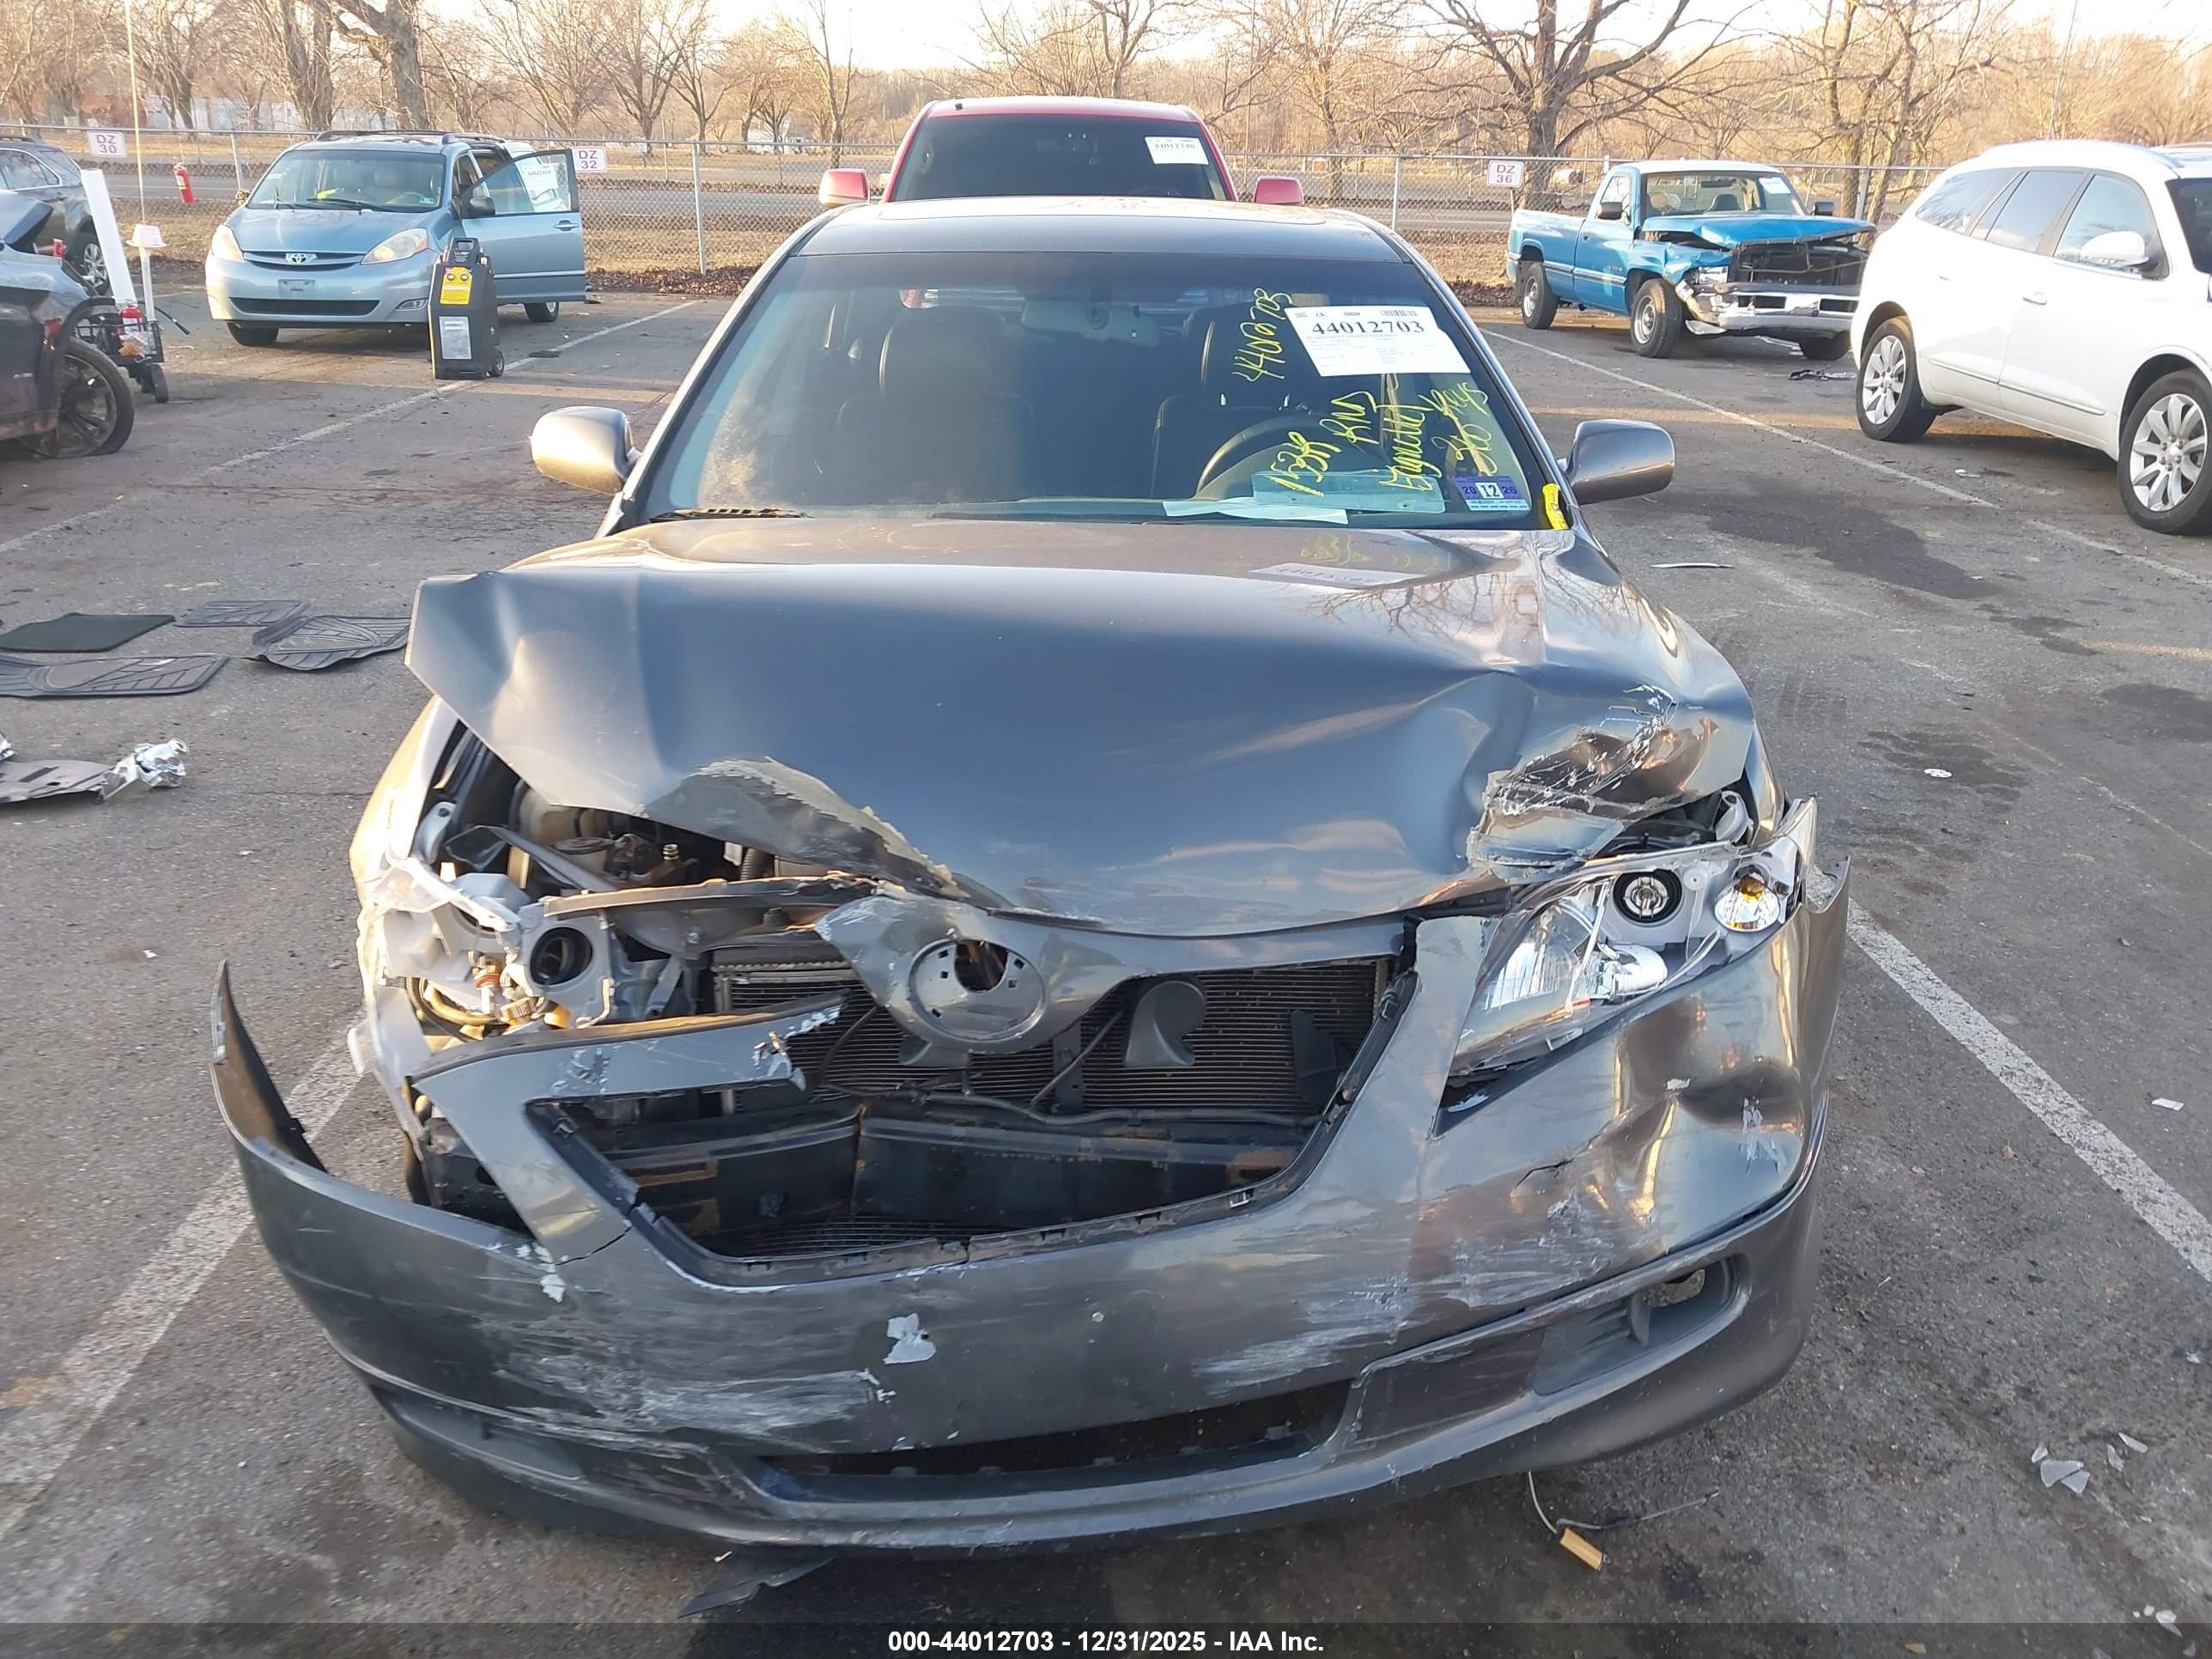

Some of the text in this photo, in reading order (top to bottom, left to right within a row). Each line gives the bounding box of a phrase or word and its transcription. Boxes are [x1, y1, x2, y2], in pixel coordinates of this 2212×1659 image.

[96, 134, 117, 144] DZ
[100, 144, 116, 153] 30
[578, 150, 598, 160] DZ
[580, 160, 598, 169] 32
[1497, 164, 1516, 173] DZ
[1497, 174, 1512, 183] 36
[1311, 320, 1425, 335] 44012703
[1462, 485, 1517, 497] 20 12 26
